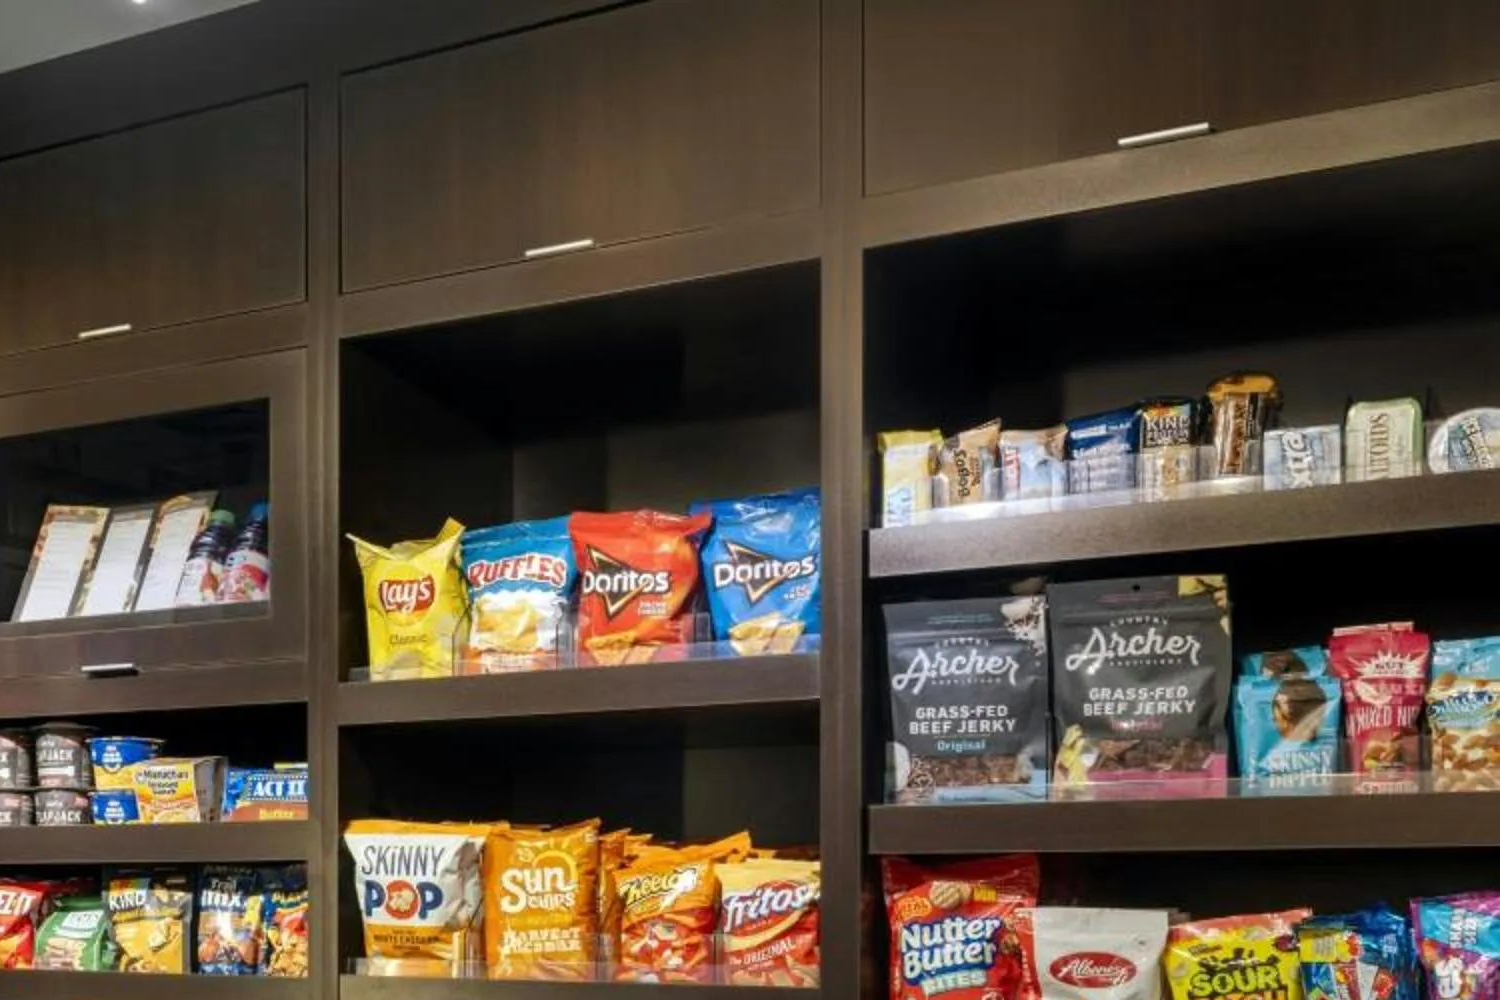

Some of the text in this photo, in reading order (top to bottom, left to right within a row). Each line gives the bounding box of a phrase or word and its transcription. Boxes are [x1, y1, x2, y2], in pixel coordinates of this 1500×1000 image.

[1281, 431, 1313, 488] xtra
[1368, 412, 1389, 478] LTOIDS
[466, 553, 567, 589] RUFFLES
[582, 570, 671, 595] Doritos
[713, 556, 814, 589] Doritos
[381, 577, 432, 613] Lay's
[1065, 627, 1201, 675] Archer
[892, 648, 1020, 695] Archer
[1083, 700, 1196, 717] BEEF JERKY
[1089, 686, 1189, 701] GRASS-FED
[909, 718, 1016, 735] BEEF JERKY
[915, 704, 1008, 719] GRASS-FED
[937, 740, 986, 753] Original
[253, 780, 284, 797] ACT
[109, 890, 147, 911] KIND
[364, 879, 442, 921] POP
[501, 865, 575, 912] Sun
[619, 868, 697, 906] Cheet
[743, 936, 797, 965] ORIGINAL
[901, 917, 1001, 952] Nutter
[903, 941, 997, 980] Butter
[921, 971, 987, 995] BITES
[1191, 965, 1279, 997] SOUR
